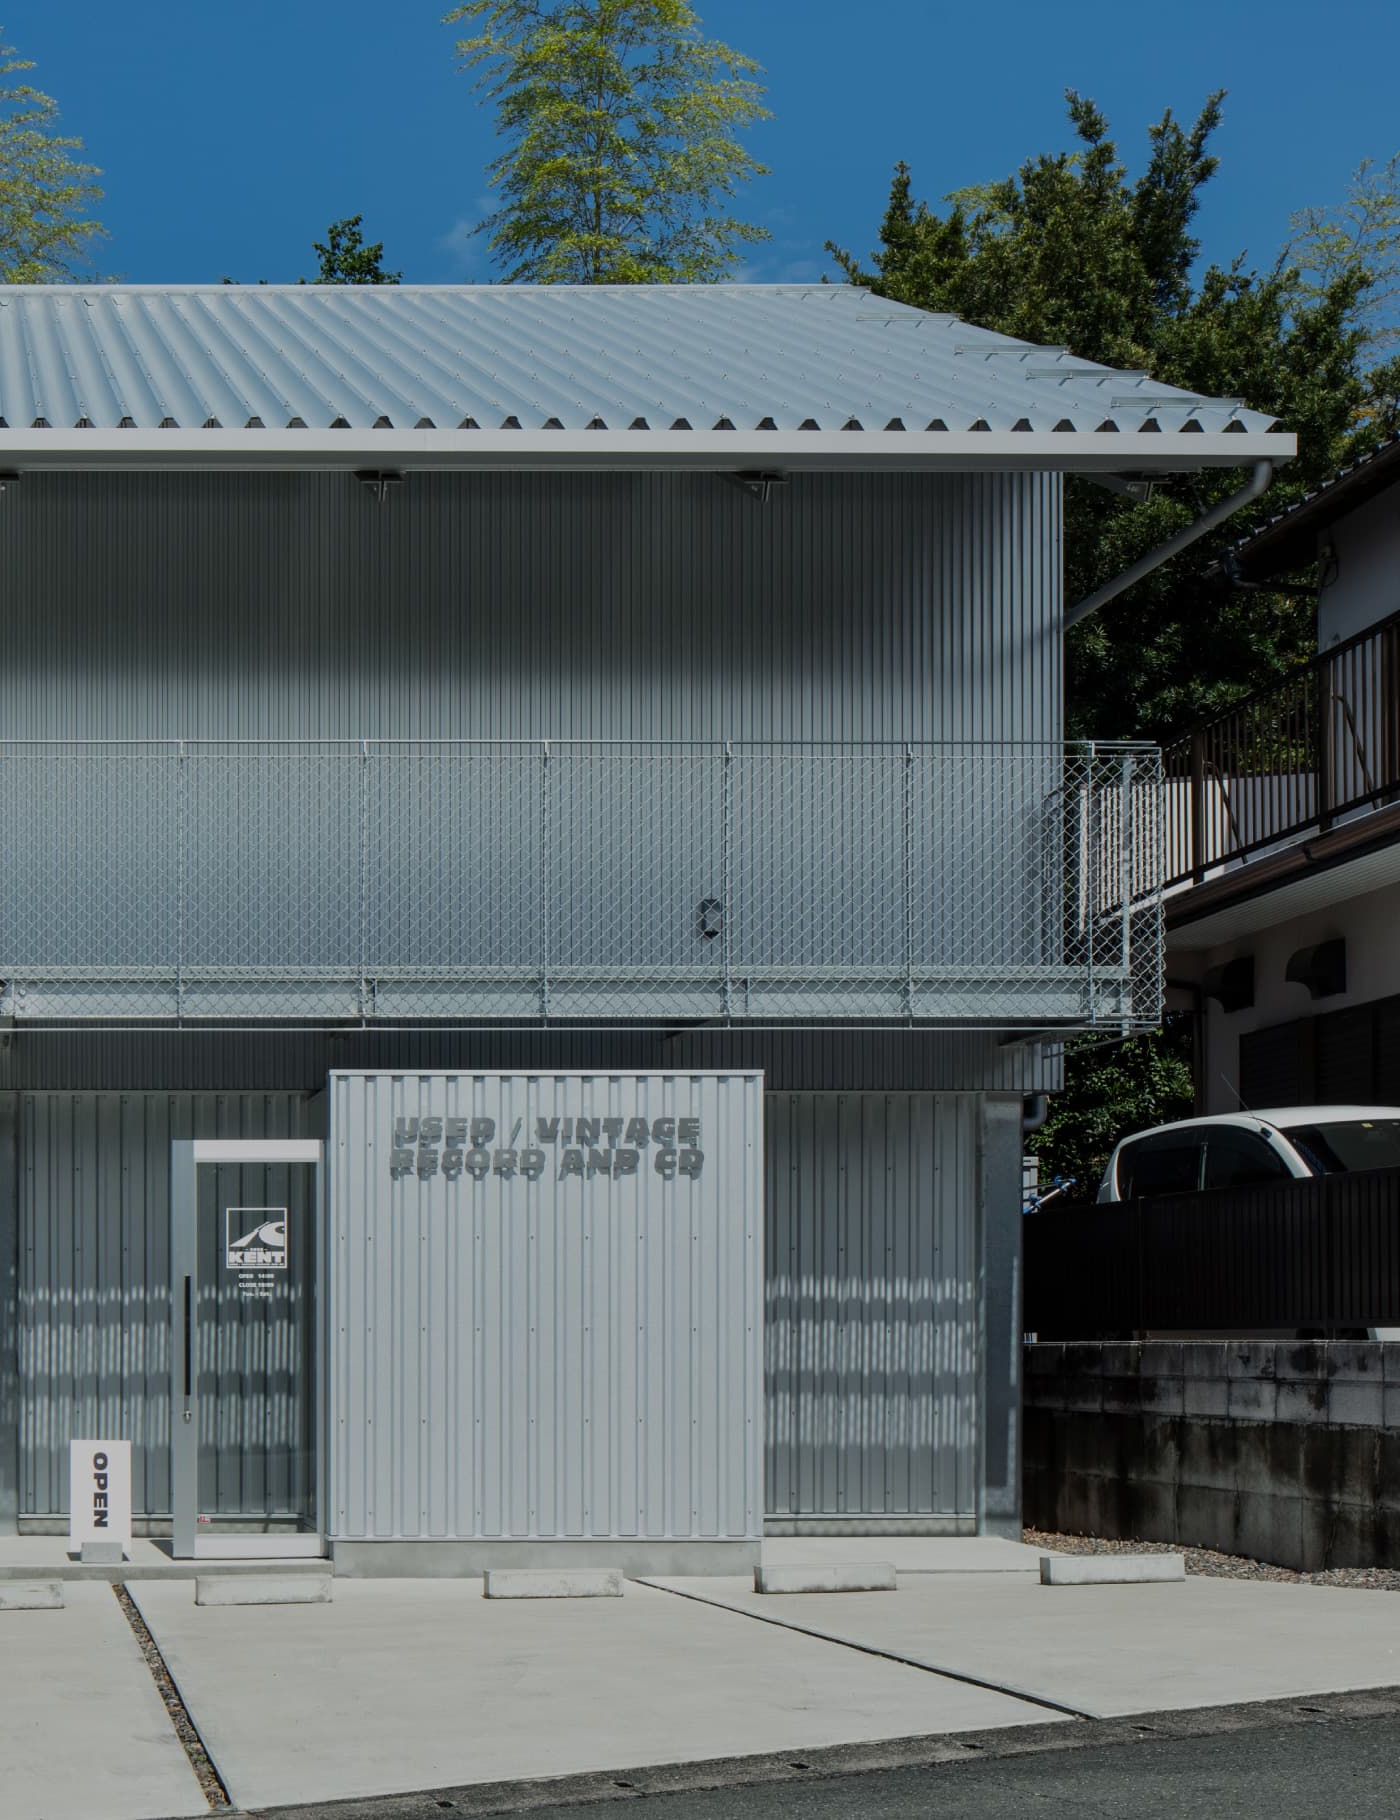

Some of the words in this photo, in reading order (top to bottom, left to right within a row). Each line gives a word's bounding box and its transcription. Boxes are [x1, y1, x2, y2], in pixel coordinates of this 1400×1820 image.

[394, 1116, 496, 1141] USED
[509, 1116, 523, 1142] /
[535, 1116, 700, 1141] VINTAGE
[390, 1149, 546, 1173] RECORD
[559, 1149, 640, 1173] AND
[655, 1149, 705, 1173] CD
[228, 1251, 284, 1264] KENT
[93, 1452, 108, 1528] OPEN
